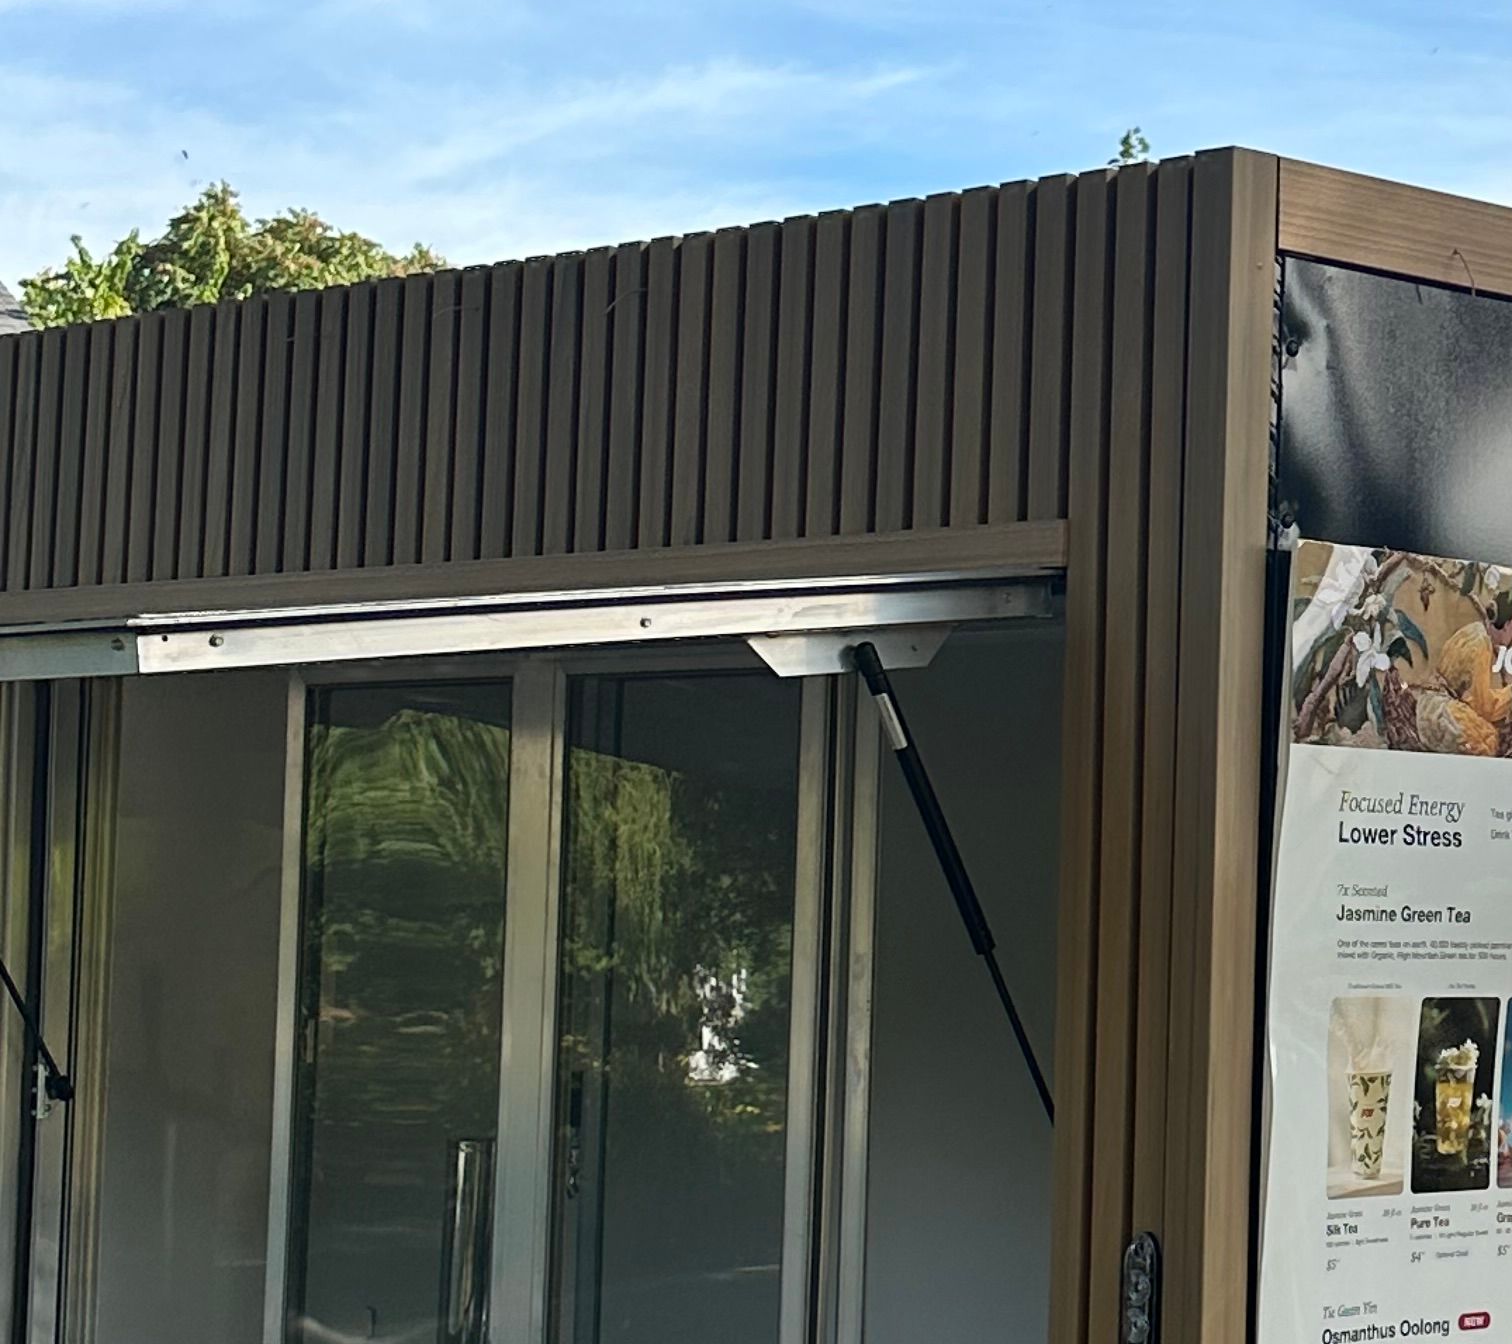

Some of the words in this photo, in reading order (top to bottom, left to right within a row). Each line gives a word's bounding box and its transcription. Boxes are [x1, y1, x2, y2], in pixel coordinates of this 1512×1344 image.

[1339, 790, 1405, 815] Focused
[1408, 794, 1466, 823] Energy
[1339, 821, 1398, 845] Lower
[1403, 824, 1463, 848] Stress
[1336, 904, 1398, 922] Jasmine
[1400, 905, 1443, 923] Green
[1447, 906, 1472, 923] Tea
[1326, 1224, 1341, 1236] Silk
[1343, 1222, 1358, 1235] Tea
[1410, 1217, 1431, 1229] Pure
[1432, 1216, 1450, 1227] Tea
[1400, 1318, 1451, 1337] Oolong
